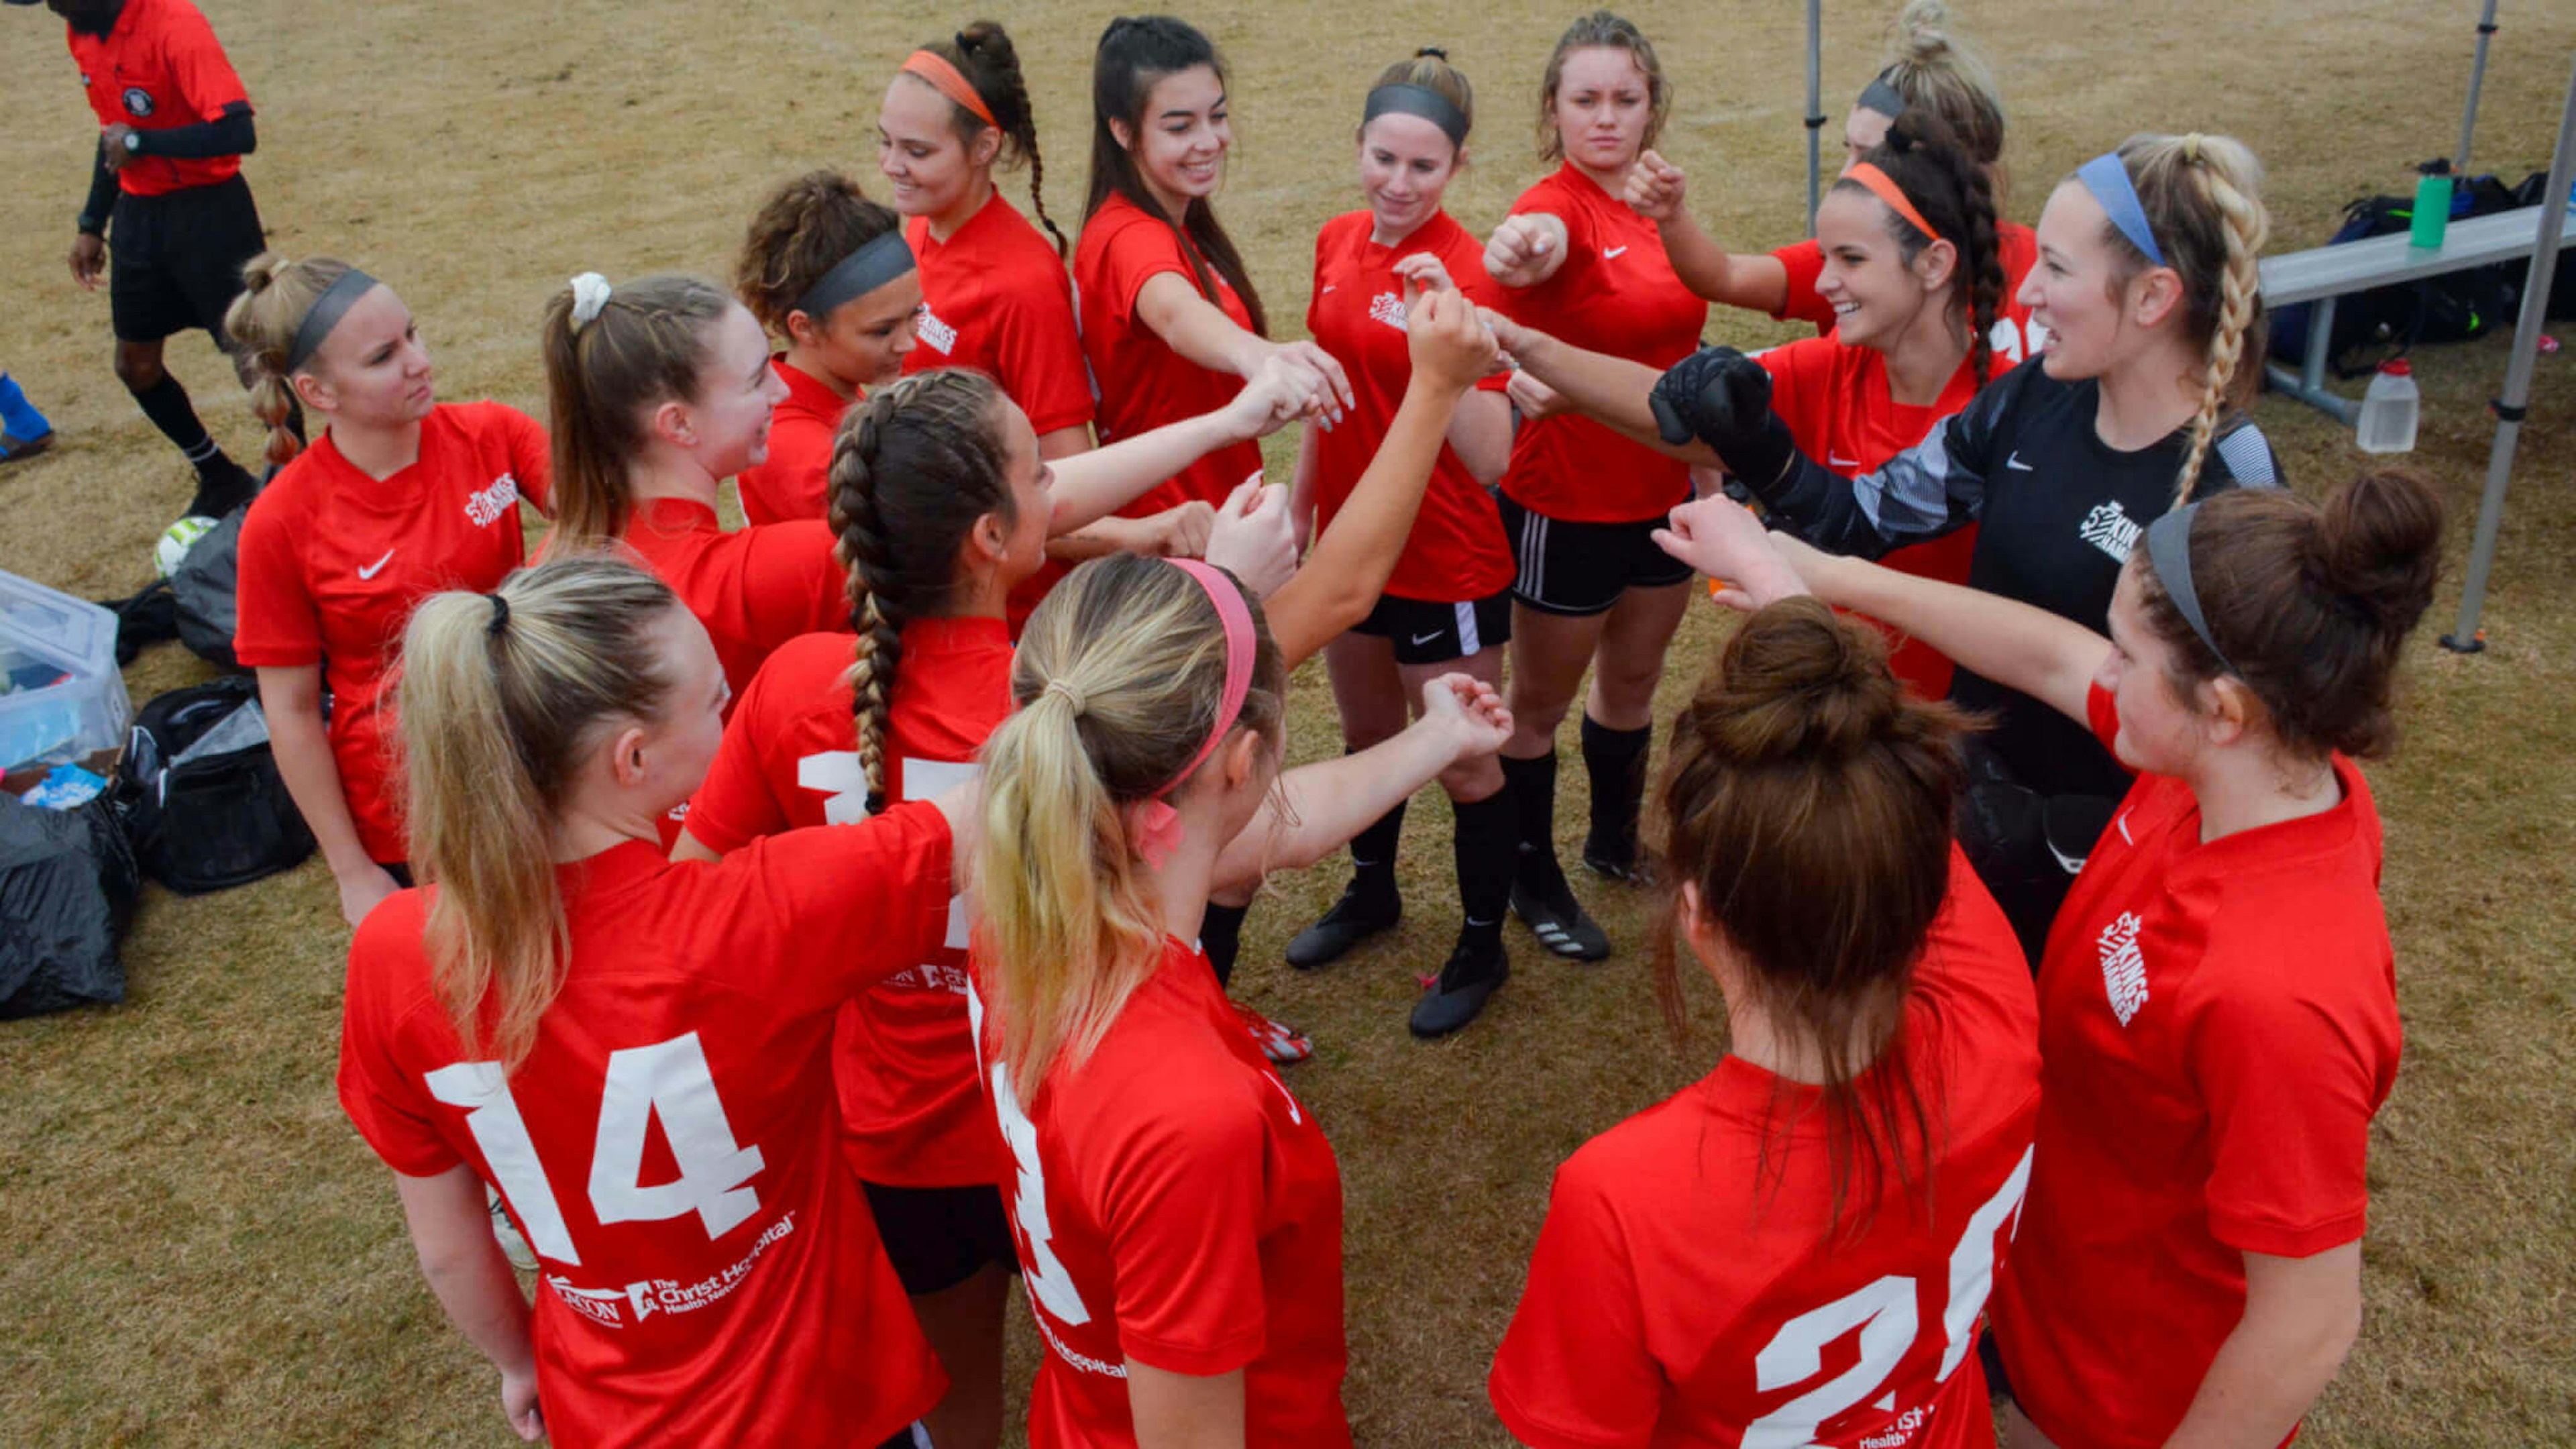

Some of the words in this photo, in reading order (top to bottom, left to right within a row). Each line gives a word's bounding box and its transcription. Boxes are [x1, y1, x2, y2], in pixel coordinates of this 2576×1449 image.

[2108, 514, 2144, 549] KIN
[2115, 937, 2149, 1014] KINGS
[423, 1030, 765, 1267] 14
[653, 1279, 679, 1290] The
[659, 1276, 721, 1303] Christ
[664, 1297, 707, 1315] Health
